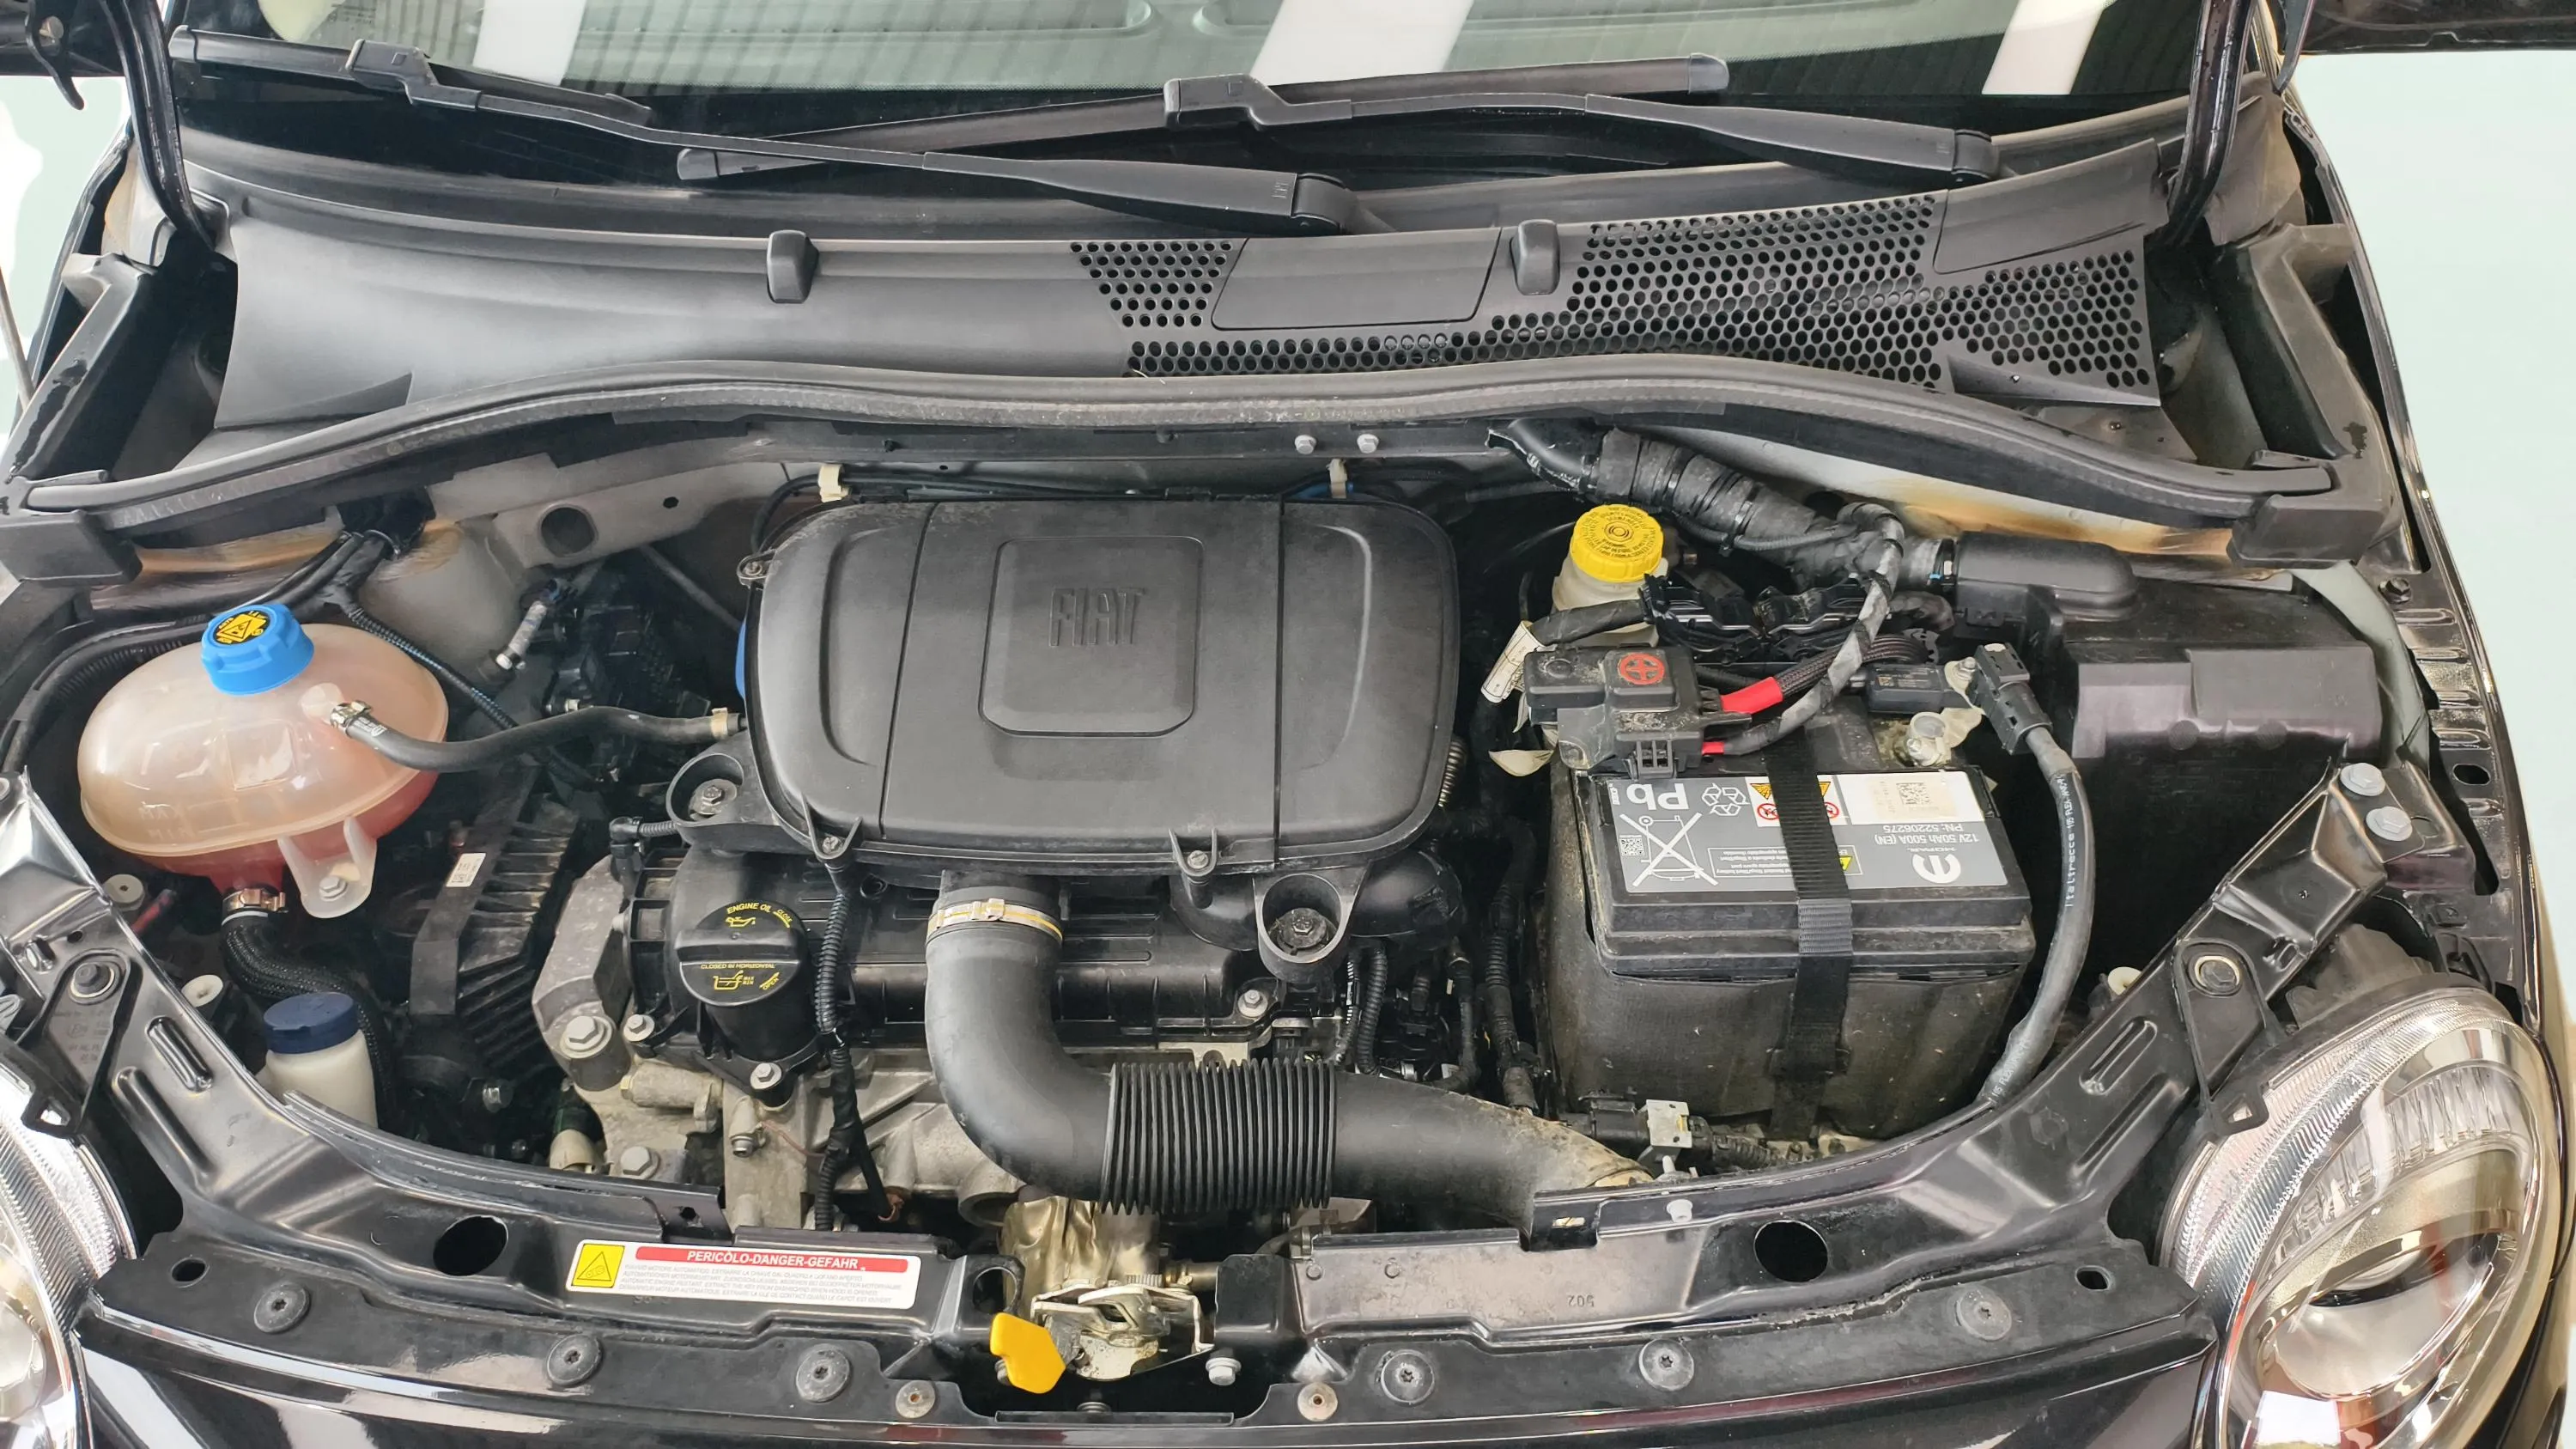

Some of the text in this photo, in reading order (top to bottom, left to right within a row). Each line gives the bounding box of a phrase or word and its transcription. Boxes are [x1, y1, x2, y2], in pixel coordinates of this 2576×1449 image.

[1049, 587, 1145, 647] FIAT
[1626, 782, 1690, 811] Pb
[1882, 823, 1965, 833] PN: 52206275
[1874, 833, 1979, 845] 12V 50Ah 500A (EN)
[726, 902, 772, 915] ENGINE OIL
